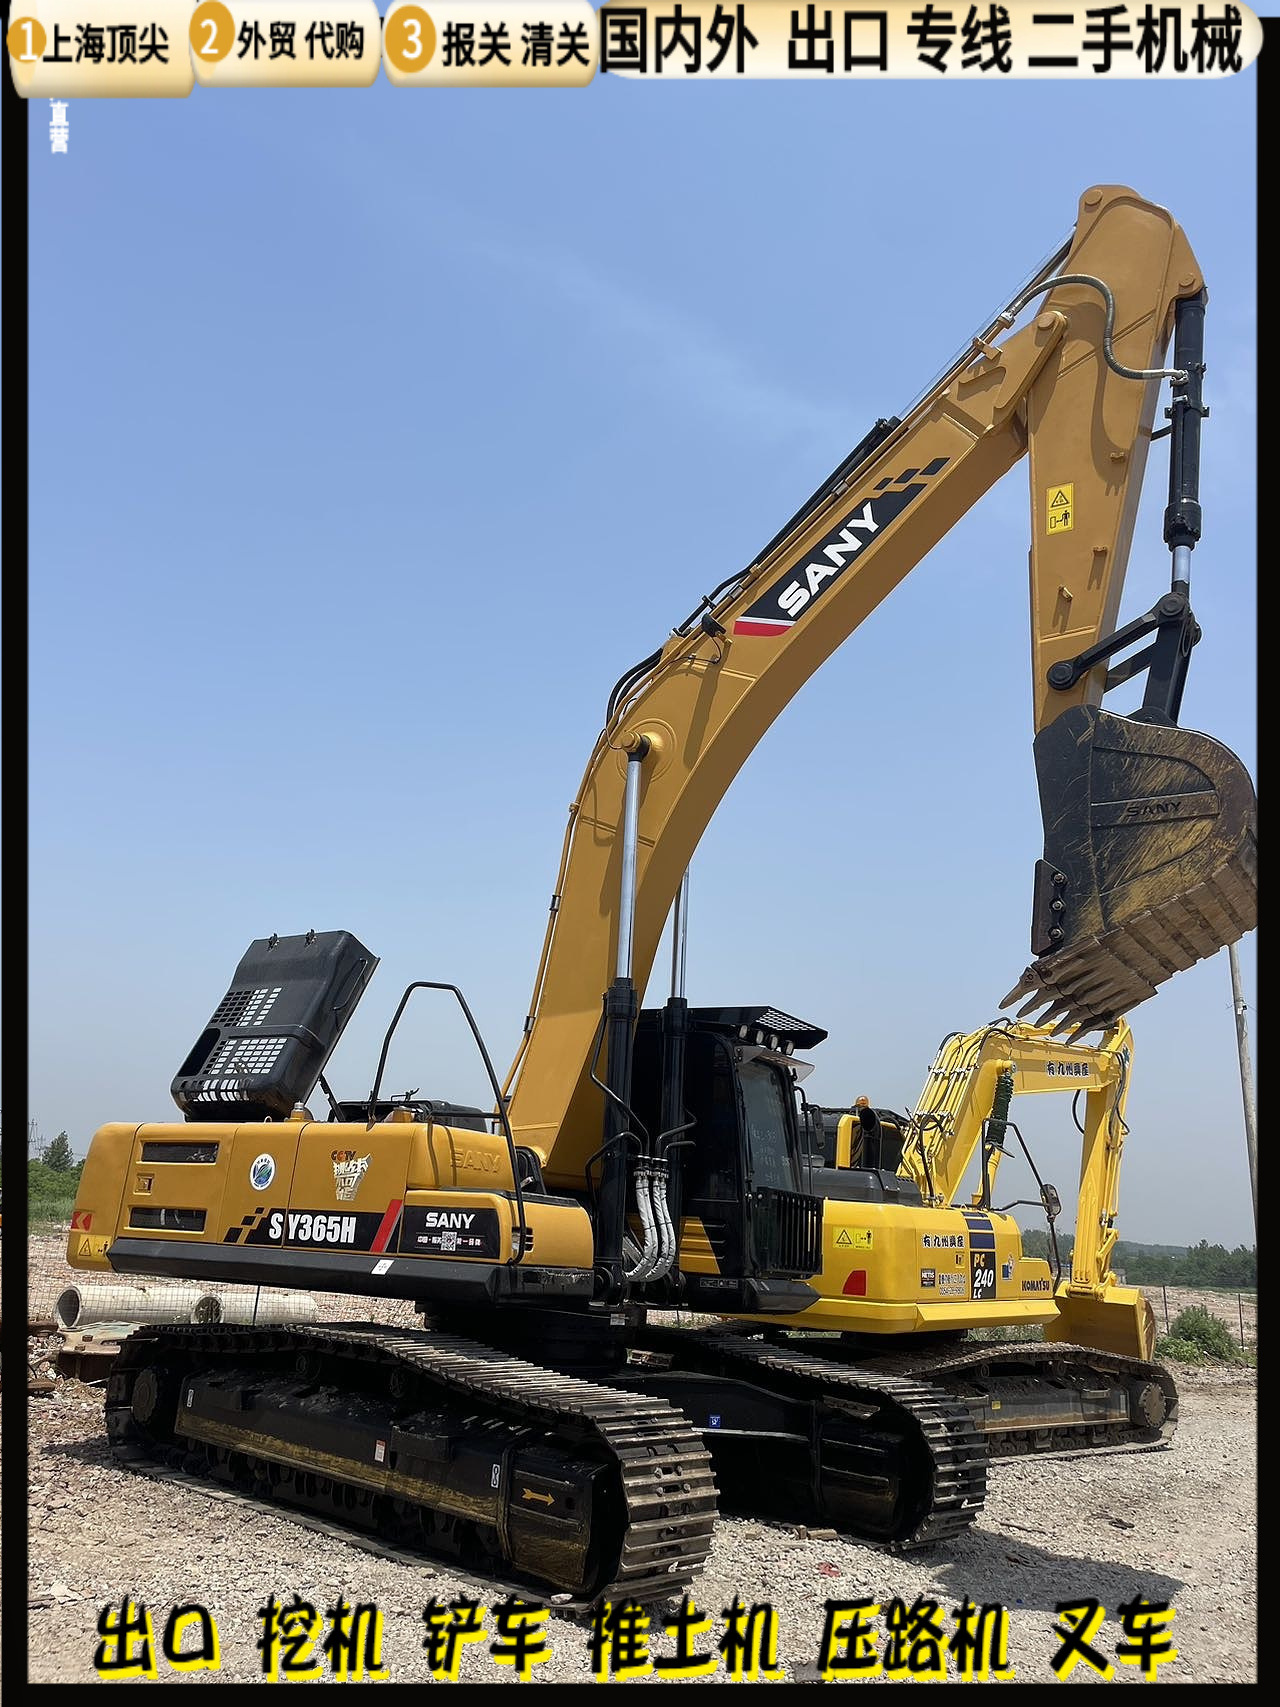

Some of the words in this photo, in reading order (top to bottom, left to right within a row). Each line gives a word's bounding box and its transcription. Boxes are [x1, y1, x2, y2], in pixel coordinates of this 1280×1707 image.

[777, 501, 881, 618] SANY
[1126, 801, 1182, 817] SANY
[450, 1147, 501, 1174] SANY
[268, 1212, 357, 1244] SY365H
[425, 1211, 476, 1230] SANY
[973, 1252, 986, 1268] PC
[973, 1268, 995, 1288] 240
[1021, 1278, 1051, 1292] KOMATSU
[972, 1287, 983, 1299] LC
